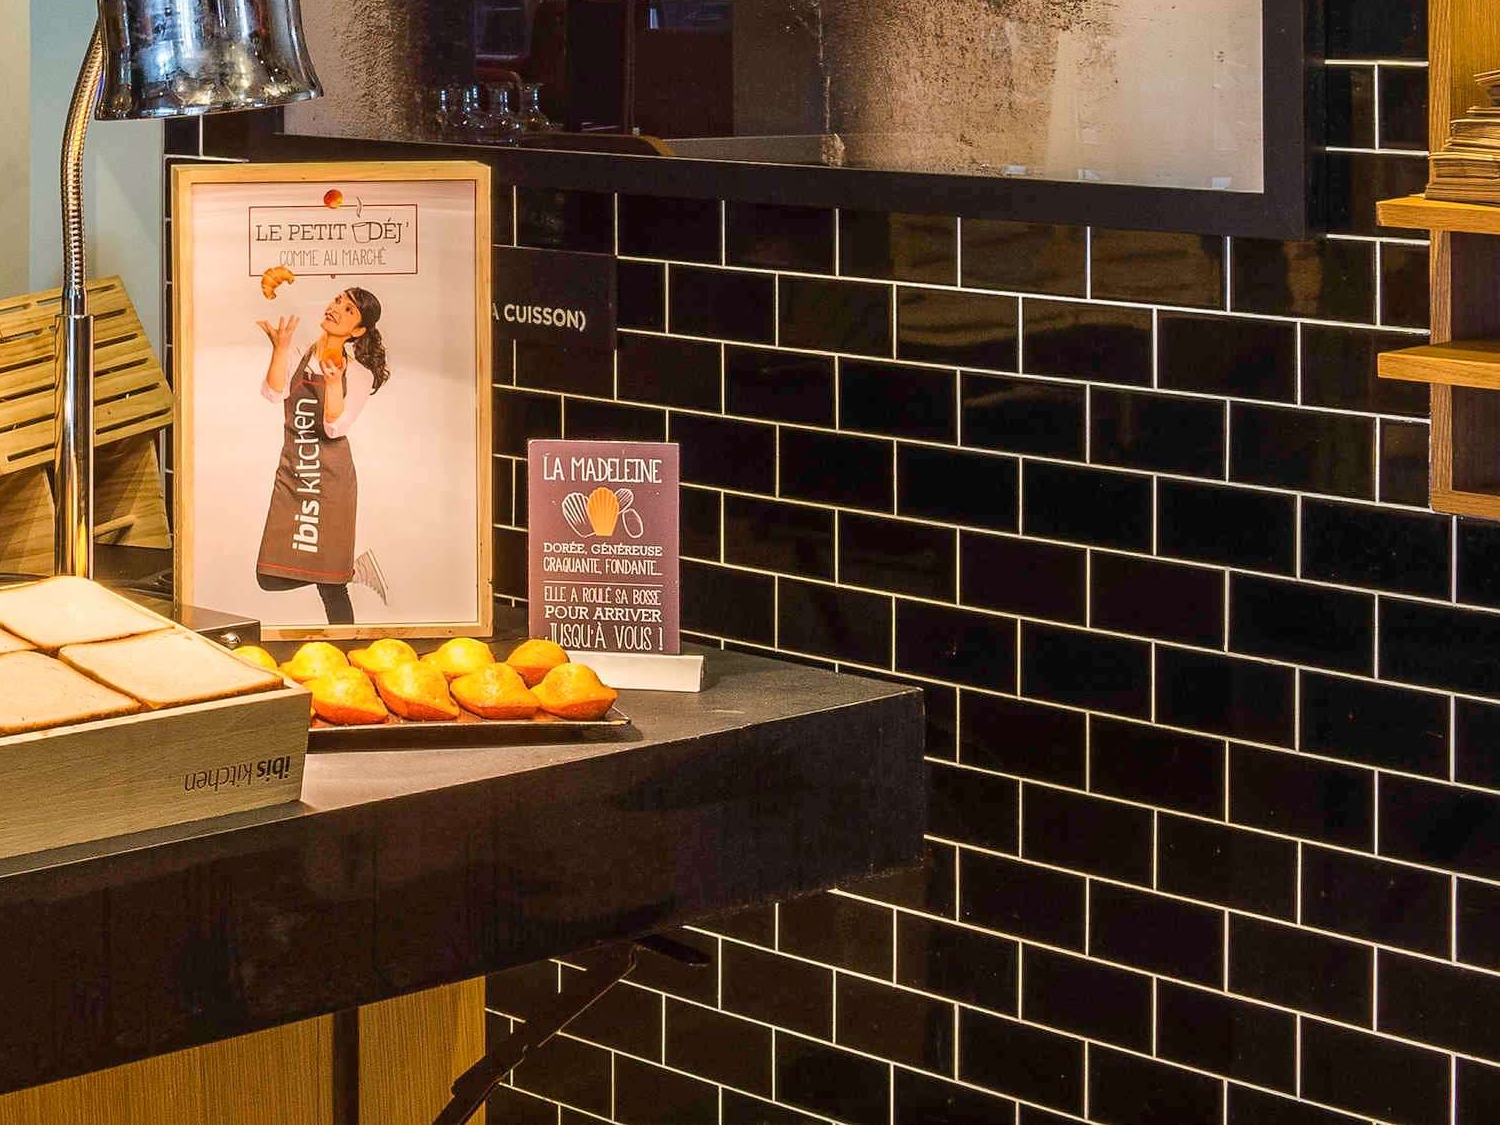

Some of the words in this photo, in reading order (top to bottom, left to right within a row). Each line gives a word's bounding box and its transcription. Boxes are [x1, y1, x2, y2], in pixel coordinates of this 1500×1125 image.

[256, 224, 282, 242] LE
[288, 224, 347, 241] PETIT
[280, 249, 319, 267] COMME
[324, 249, 338, 266] AU
[342, 247, 387, 266] MARCHÉ
[504, 304, 586, 332] CUISSON)
[294, 398, 320, 494] kitchen
[543, 454, 565, 481] LA
[571, 457, 662, 483] MADELEINE
[292, 500, 320, 553] ibis
[591, 542, 663, 557] GÉNÉREUSE
[544, 586, 566, 602] ELLE
[571, 586, 578, 602] A
[582, 586, 612, 604] ROULÉ
[615, 589, 628, 604] SA
[633, 589, 661, 605] BOSSE
[544, 605, 590, 620] POUR
[593, 607, 662, 622] ARRIVER
[614, 625, 652, 651] VOUS
[184, 762, 252, 792] kitchen
[257, 756, 291, 782] ibis
